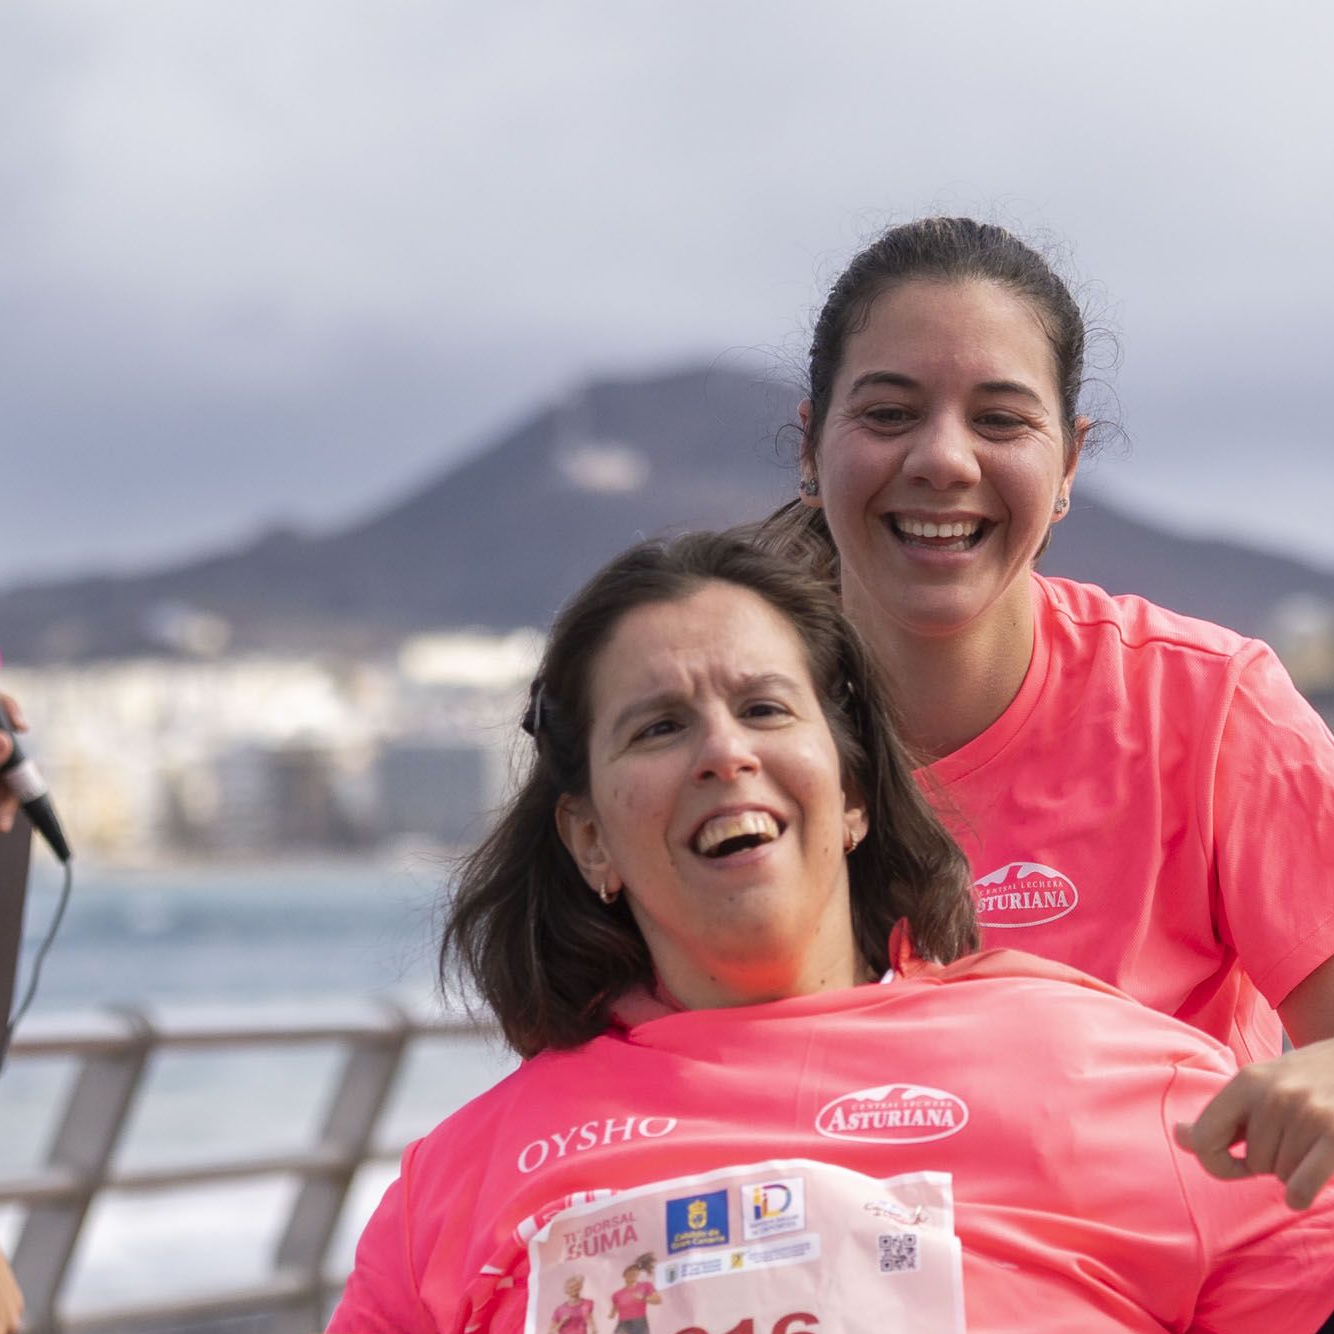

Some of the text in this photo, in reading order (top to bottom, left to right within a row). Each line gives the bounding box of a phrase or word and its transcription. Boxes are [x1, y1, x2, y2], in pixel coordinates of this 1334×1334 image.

[1020, 880, 1065, 889] LECHERA
[975, 890, 1069, 914] STURIANA
[826, 1107, 956, 1132] ASTURIANA
[517, 1116, 678, 1174] OYSHO
[584, 1211, 637, 1237] DORSAL
[567, 1224, 638, 1261] SUMA
